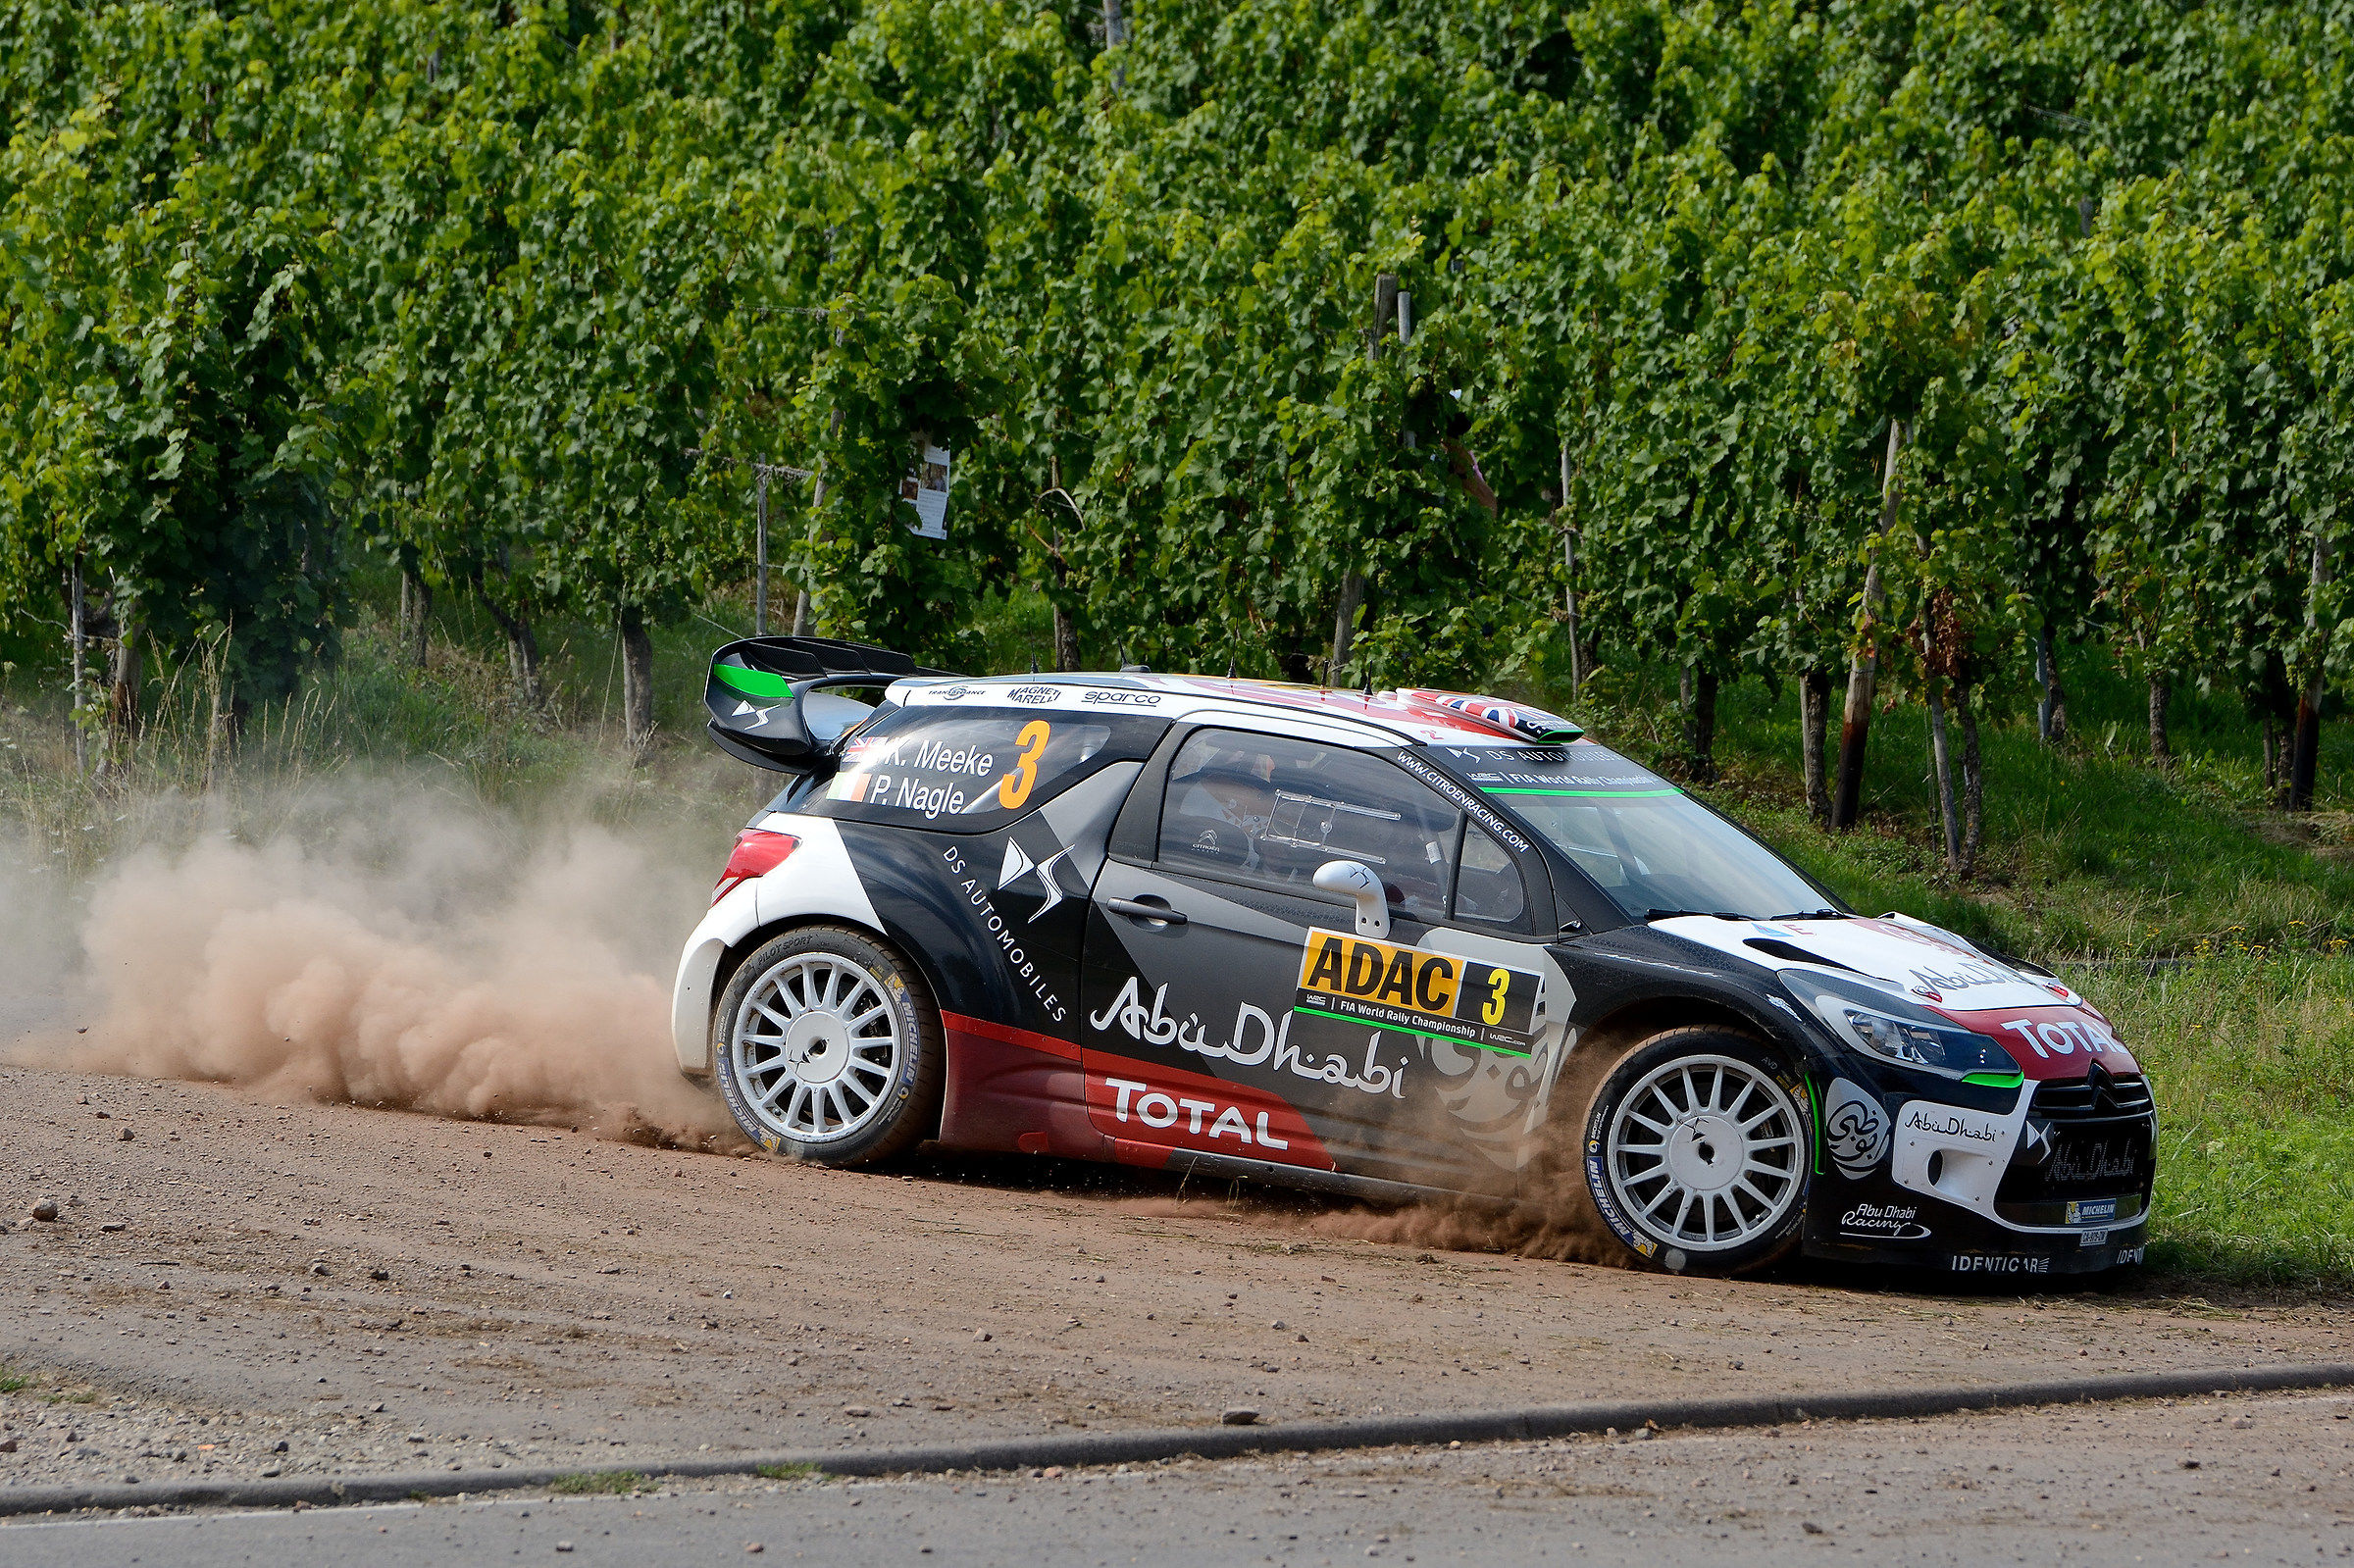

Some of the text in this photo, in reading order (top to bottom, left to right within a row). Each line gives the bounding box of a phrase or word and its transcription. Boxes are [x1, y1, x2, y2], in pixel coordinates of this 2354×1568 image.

[1006, 685, 1062, 698] MAGNETI
[1006, 691, 1062, 704] MARELLI
[1084, 690, 1161, 705] sparco
[885, 736, 994, 777] K. Meeke
[998, 719, 1051, 810] 3
[1484, 750, 1515, 761] DS
[870, 775, 964, 820] P. Nagle
[1509, 772, 1539, 784] FIA
[1397, 750, 1530, 854] WWW.CITROENRACING.COM
[944, 845, 1067, 1022] DS AUTOMOBILES
[1307, 936, 1454, 1011] ADAC
[1482, 968, 1510, 1026] 3
[1340, 1000, 1356, 1013] FIA
[1357, 1003, 1385, 1018] World
[1386, 1010, 1410, 1025] Rally
[1411, 1014, 1476, 1038] Championship
[1104, 1077, 1289, 1150] TOTAL
[1589, 1159, 1630, 1236] MICHELIN
[1856, 1203, 1918, 1220] Abu Dhabi
[2081, 1204, 2115, 1216] MICHELIN
[1841, 1211, 1912, 1237] Racing
